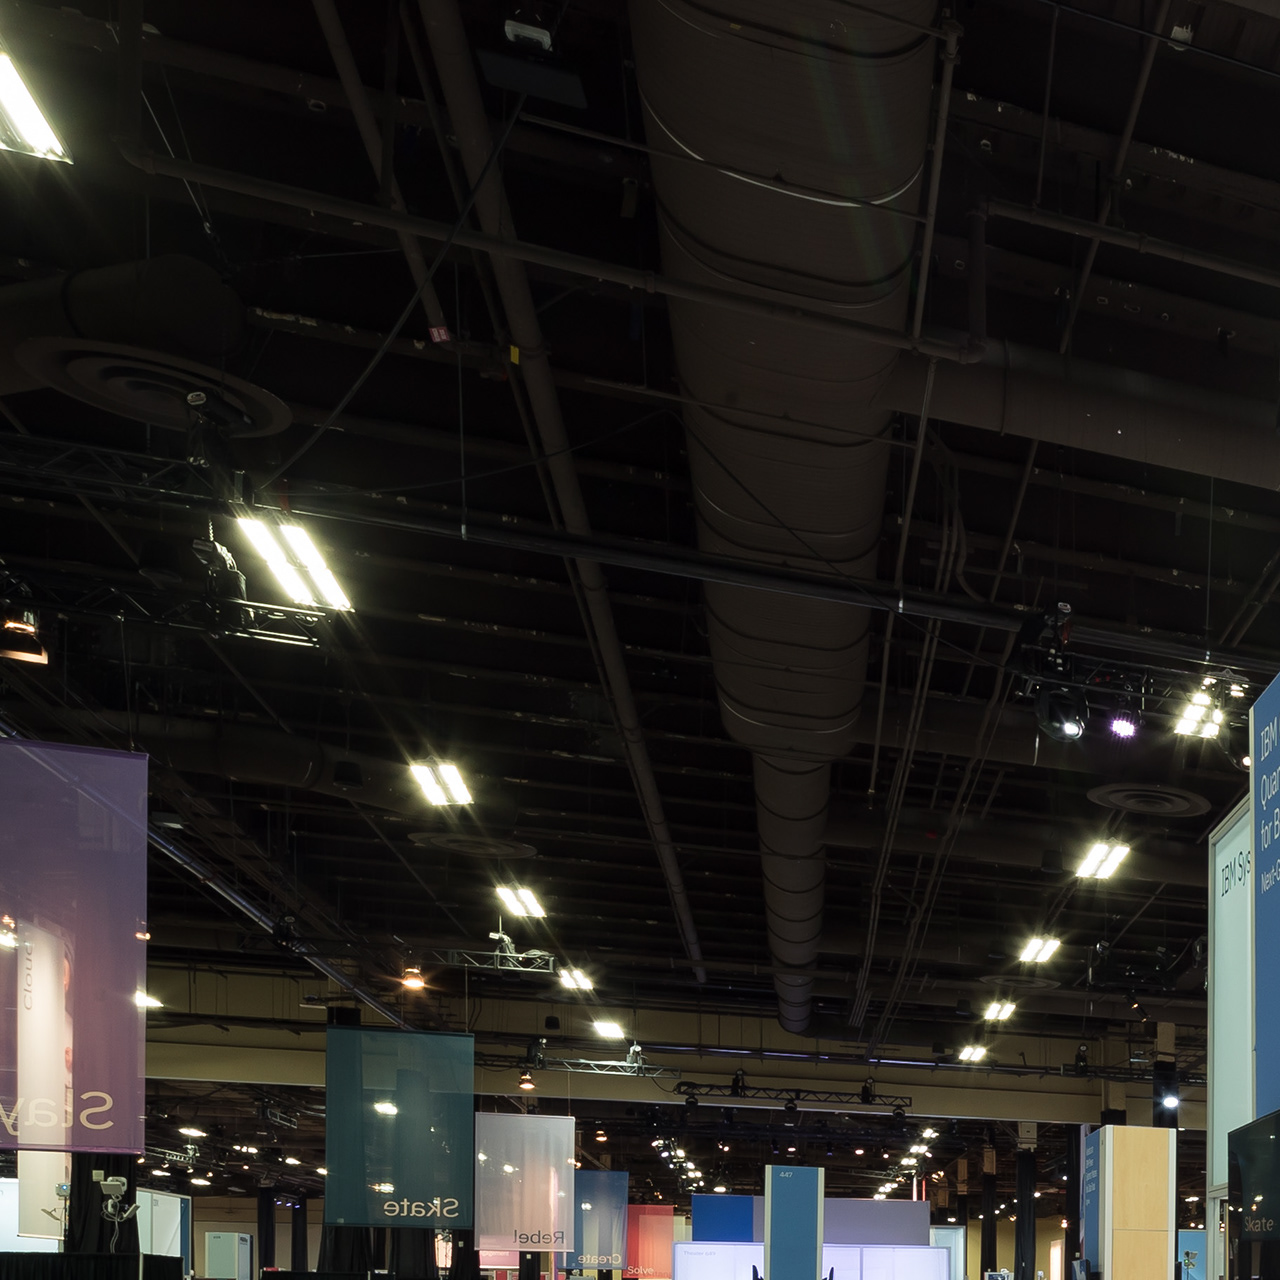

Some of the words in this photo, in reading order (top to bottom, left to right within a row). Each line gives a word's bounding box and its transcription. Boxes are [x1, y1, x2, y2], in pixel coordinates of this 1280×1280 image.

[1261, 716, 1277, 762] IBM
[1261, 819, 1272, 851] for
[1221, 859, 1236, 897] IBM
[1244, 1216, 1274, 1232] Skate
[627, 1265, 654, 1275] Solve
